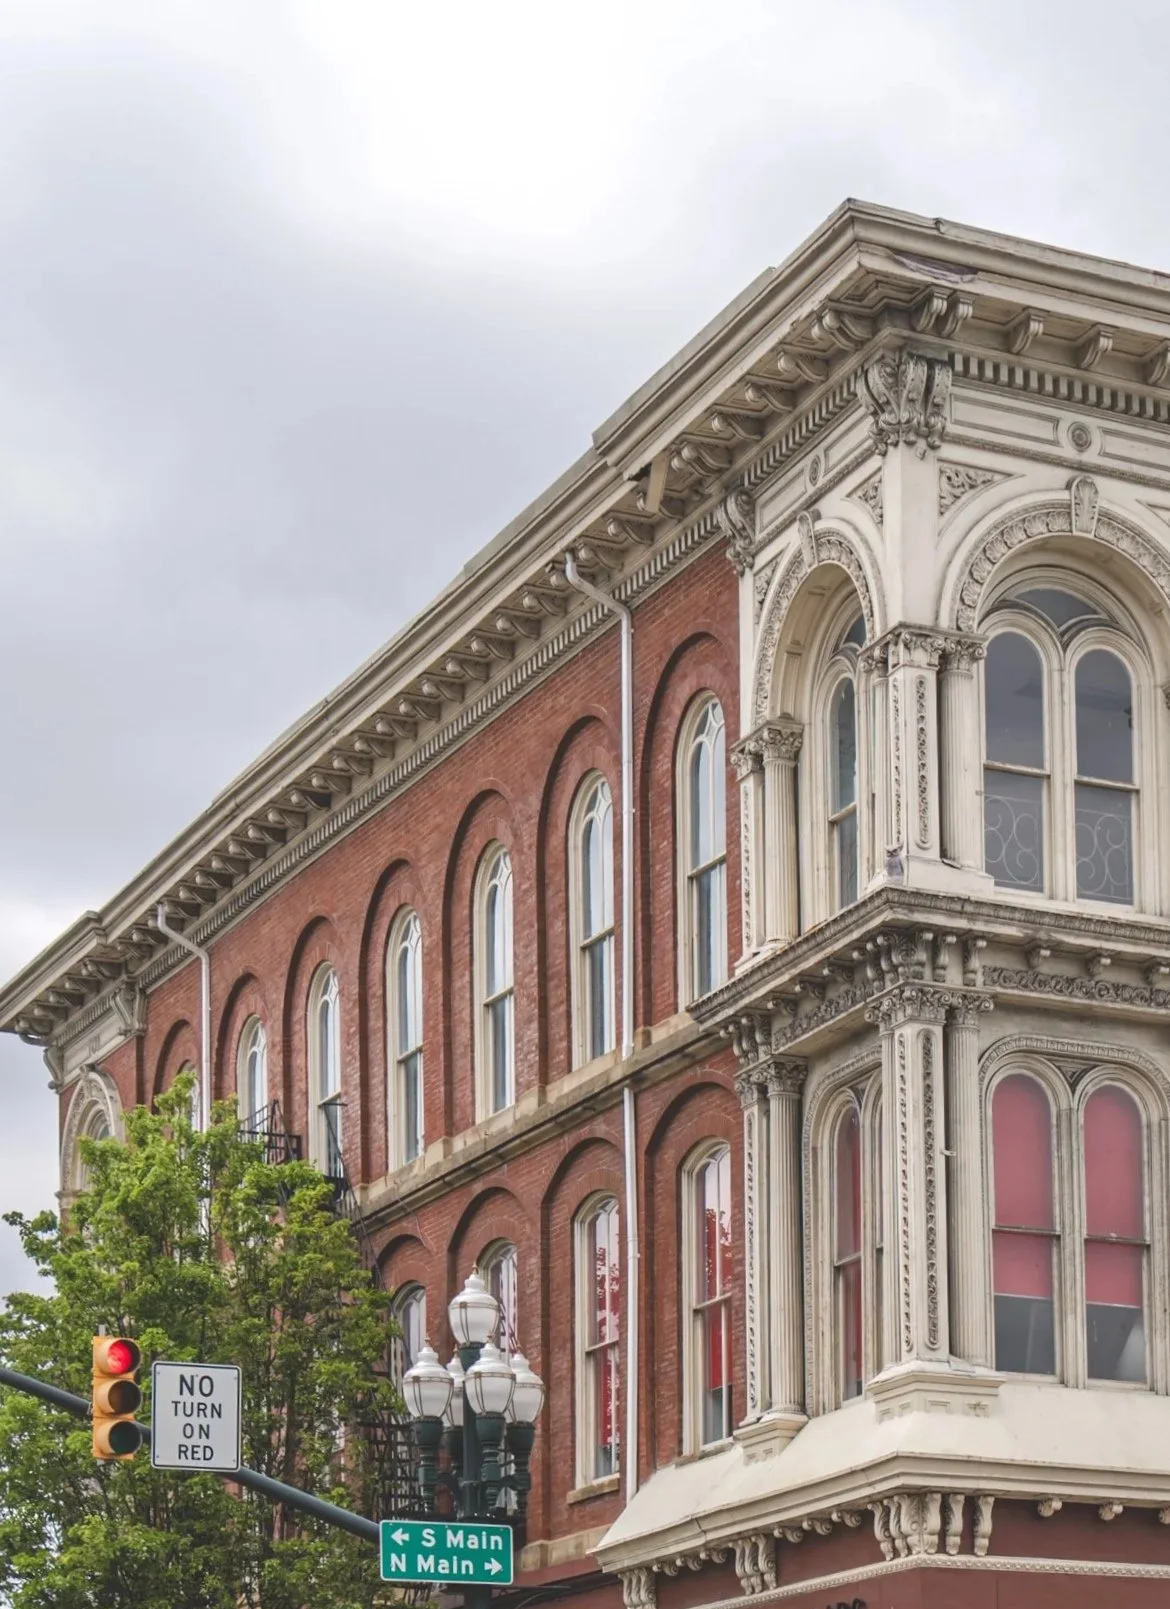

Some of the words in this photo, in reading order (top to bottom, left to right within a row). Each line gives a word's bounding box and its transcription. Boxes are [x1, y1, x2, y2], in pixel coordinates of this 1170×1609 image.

[179, 1373, 214, 1397] NO
[171, 1401, 222, 1419] TURN
[182, 1423, 210, 1440] ON
[178, 1443, 214, 1461] RED
[421, 1528, 436, 1547] S
[446, 1529, 503, 1550] Main
[390, 1553, 406, 1572] N
[417, 1554, 474, 1575] Main
